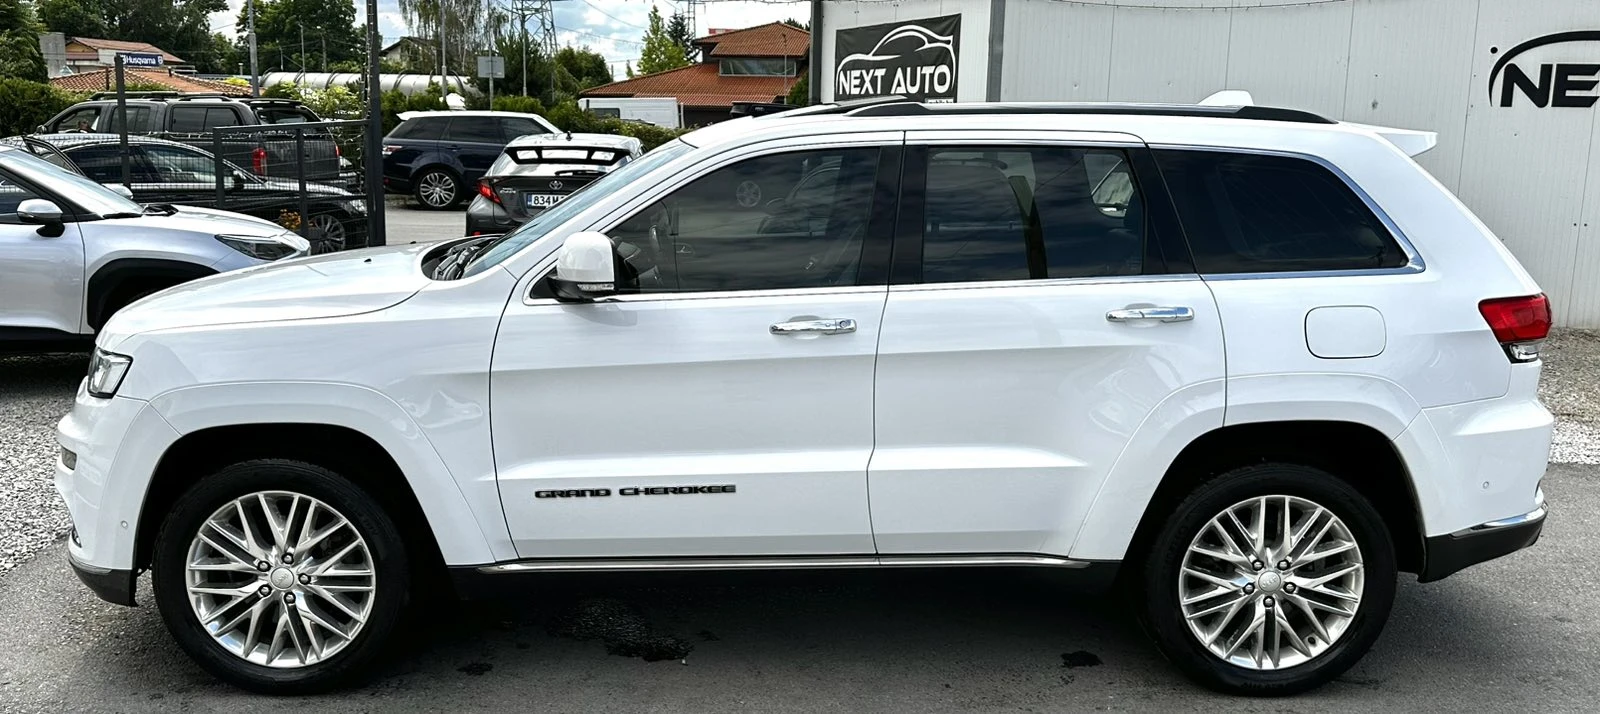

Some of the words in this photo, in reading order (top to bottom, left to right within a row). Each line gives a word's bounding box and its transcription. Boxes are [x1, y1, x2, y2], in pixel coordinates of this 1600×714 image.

[127, 55, 156, 65] Husqvarna
[840, 68, 887, 95] NEXT
[890, 64, 951, 94] AUTO
[1500, 62, 1600, 108] NE
[535, 488, 611, 498] GRAND
[618, 485, 736, 496] CHEROKEE
